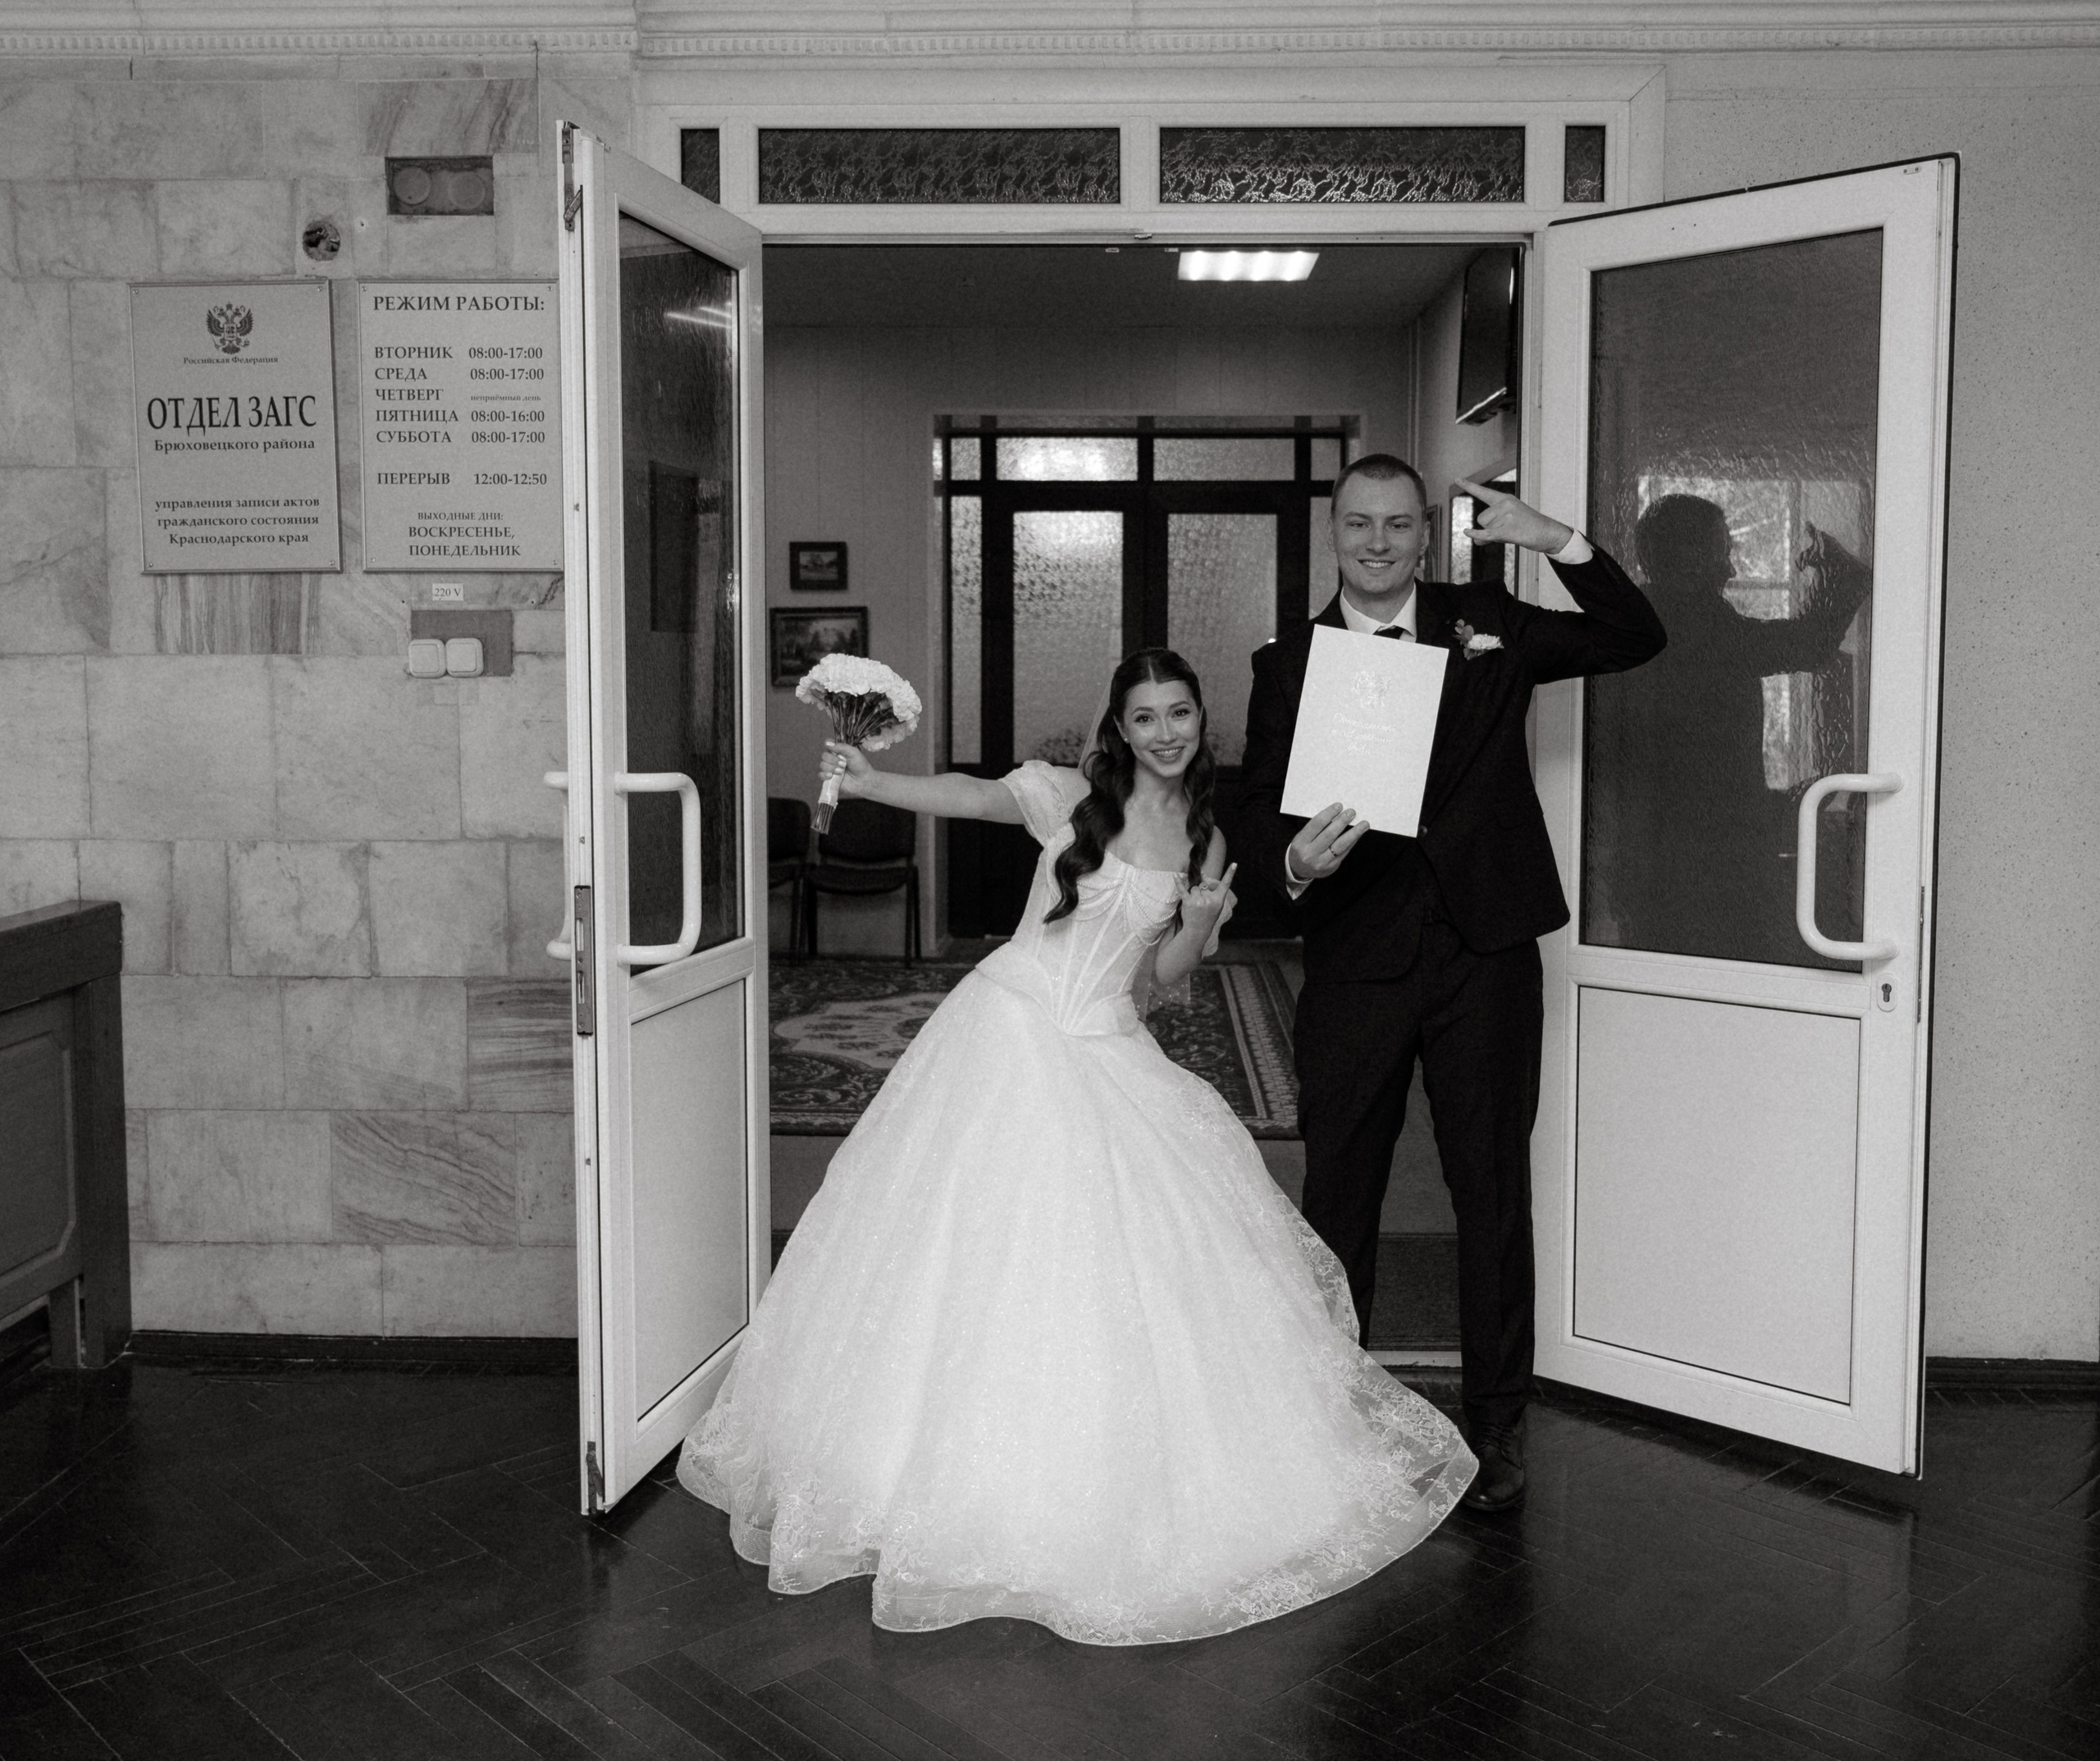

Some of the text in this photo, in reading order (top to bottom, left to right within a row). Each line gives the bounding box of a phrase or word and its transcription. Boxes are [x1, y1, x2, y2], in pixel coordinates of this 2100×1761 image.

[373, 295, 545, 312] РЕЖИМ РАБОТЫ:
[374, 346, 543, 359] ВТОРНИК 08:00-17:00
[183, 355, 279, 365] Российская Федерация
[374, 367, 545, 383] СРЕДА 08:00-17:00
[375, 388, 445, 401] ЧЕТВЕРГ
[147, 395, 317, 437] ОТДЕЛ ЗАГС
[376, 409, 546, 425] ПЯТНИЦА 08:00-16:00
[376, 430, 546, 444] СУББОТА 08:00-17:00
[153, 438, 315, 455] Брюховецкого района
[377, 472, 547, 486] ПЕРЕРЫВ 12:00-12:50
[154, 499, 320, 513] управления записи актов
[157, 516, 319, 530] гражданского состояния
[418, 512, 504, 522] ВЫХОДНЫЕ ДНИ:
[409, 526, 515, 540] ВОСКРЕСЕНЬЕ,
[169, 533, 309, 548] Краснодарского края
[409, 545, 522, 558] ПОНЕДЕЛЬНИК
[435, 588, 461, 596] 220 V
